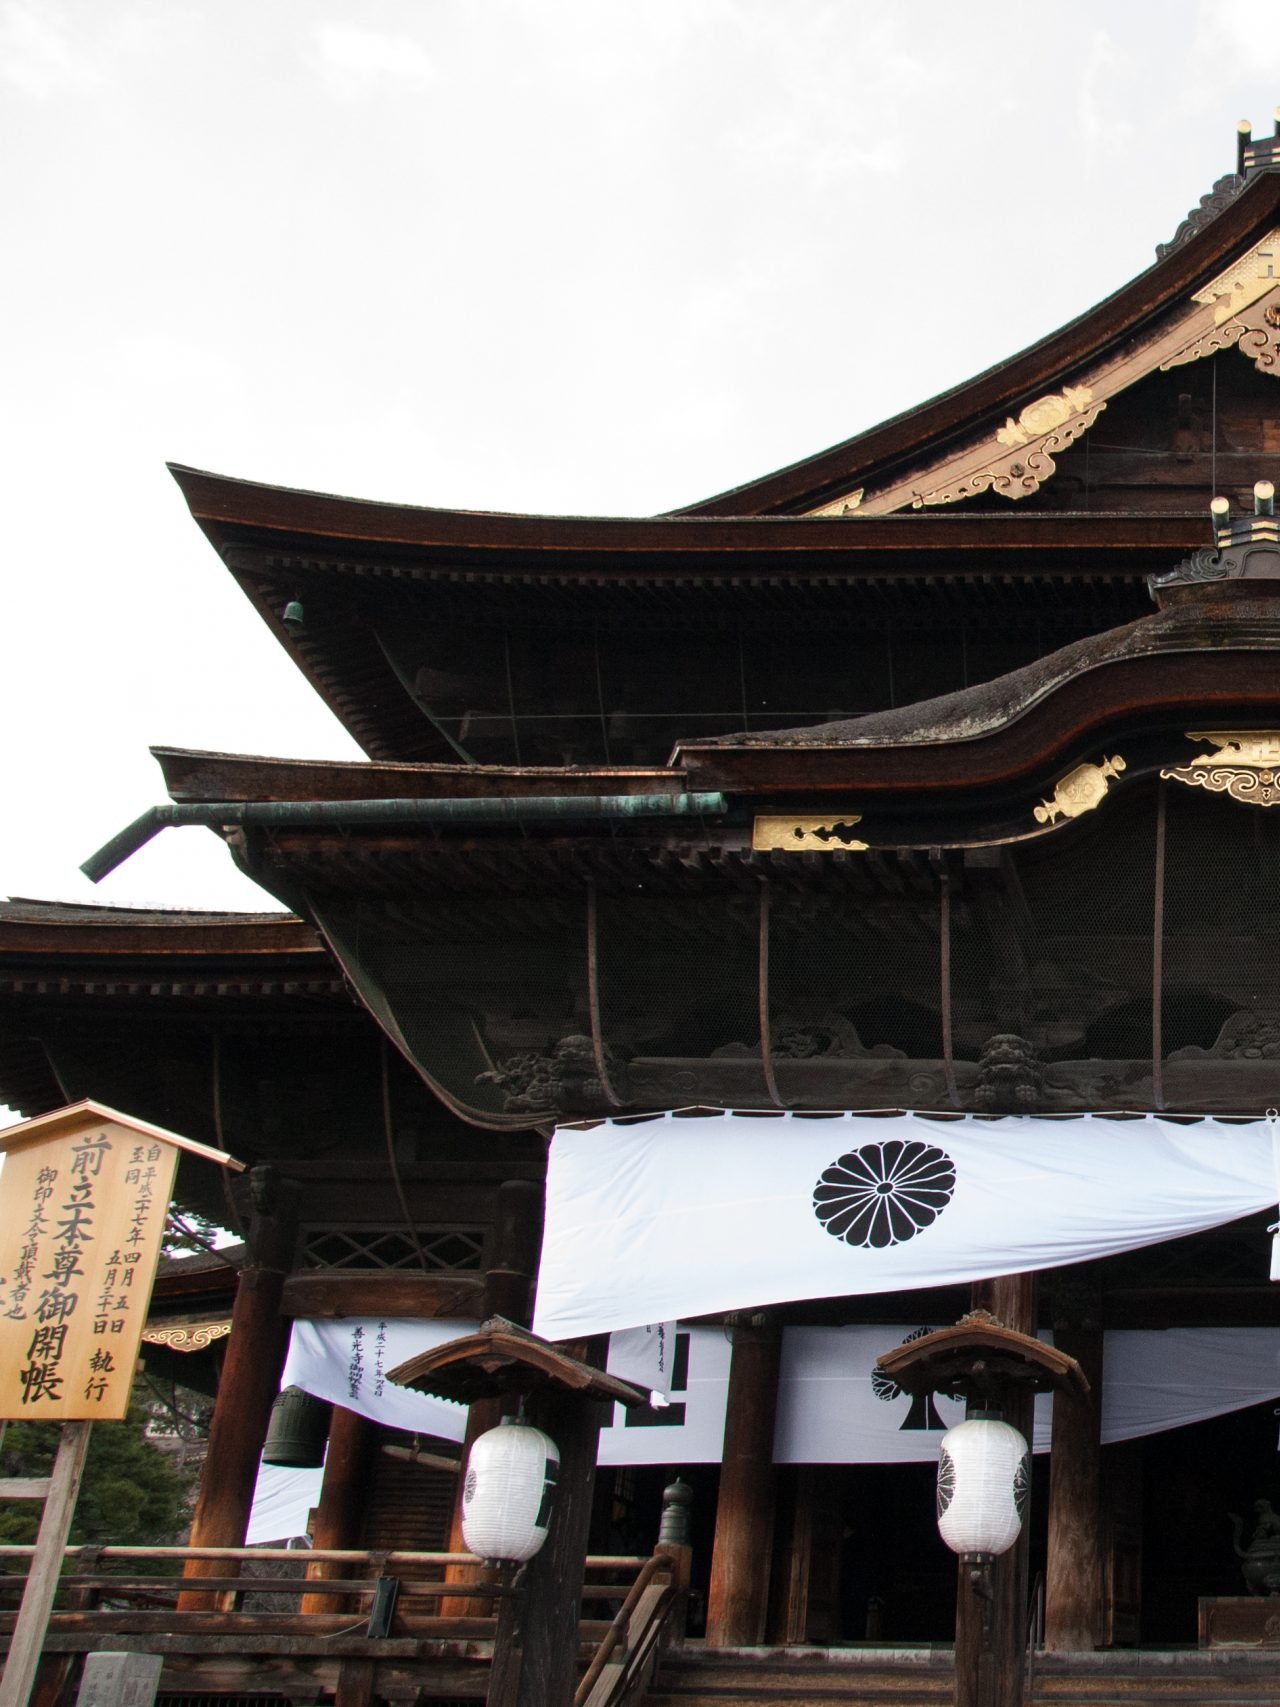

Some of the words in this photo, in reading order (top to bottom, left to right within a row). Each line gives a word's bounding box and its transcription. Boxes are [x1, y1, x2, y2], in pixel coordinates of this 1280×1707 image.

[20, 1132, 113, 1405] 前立本尊御開帳
